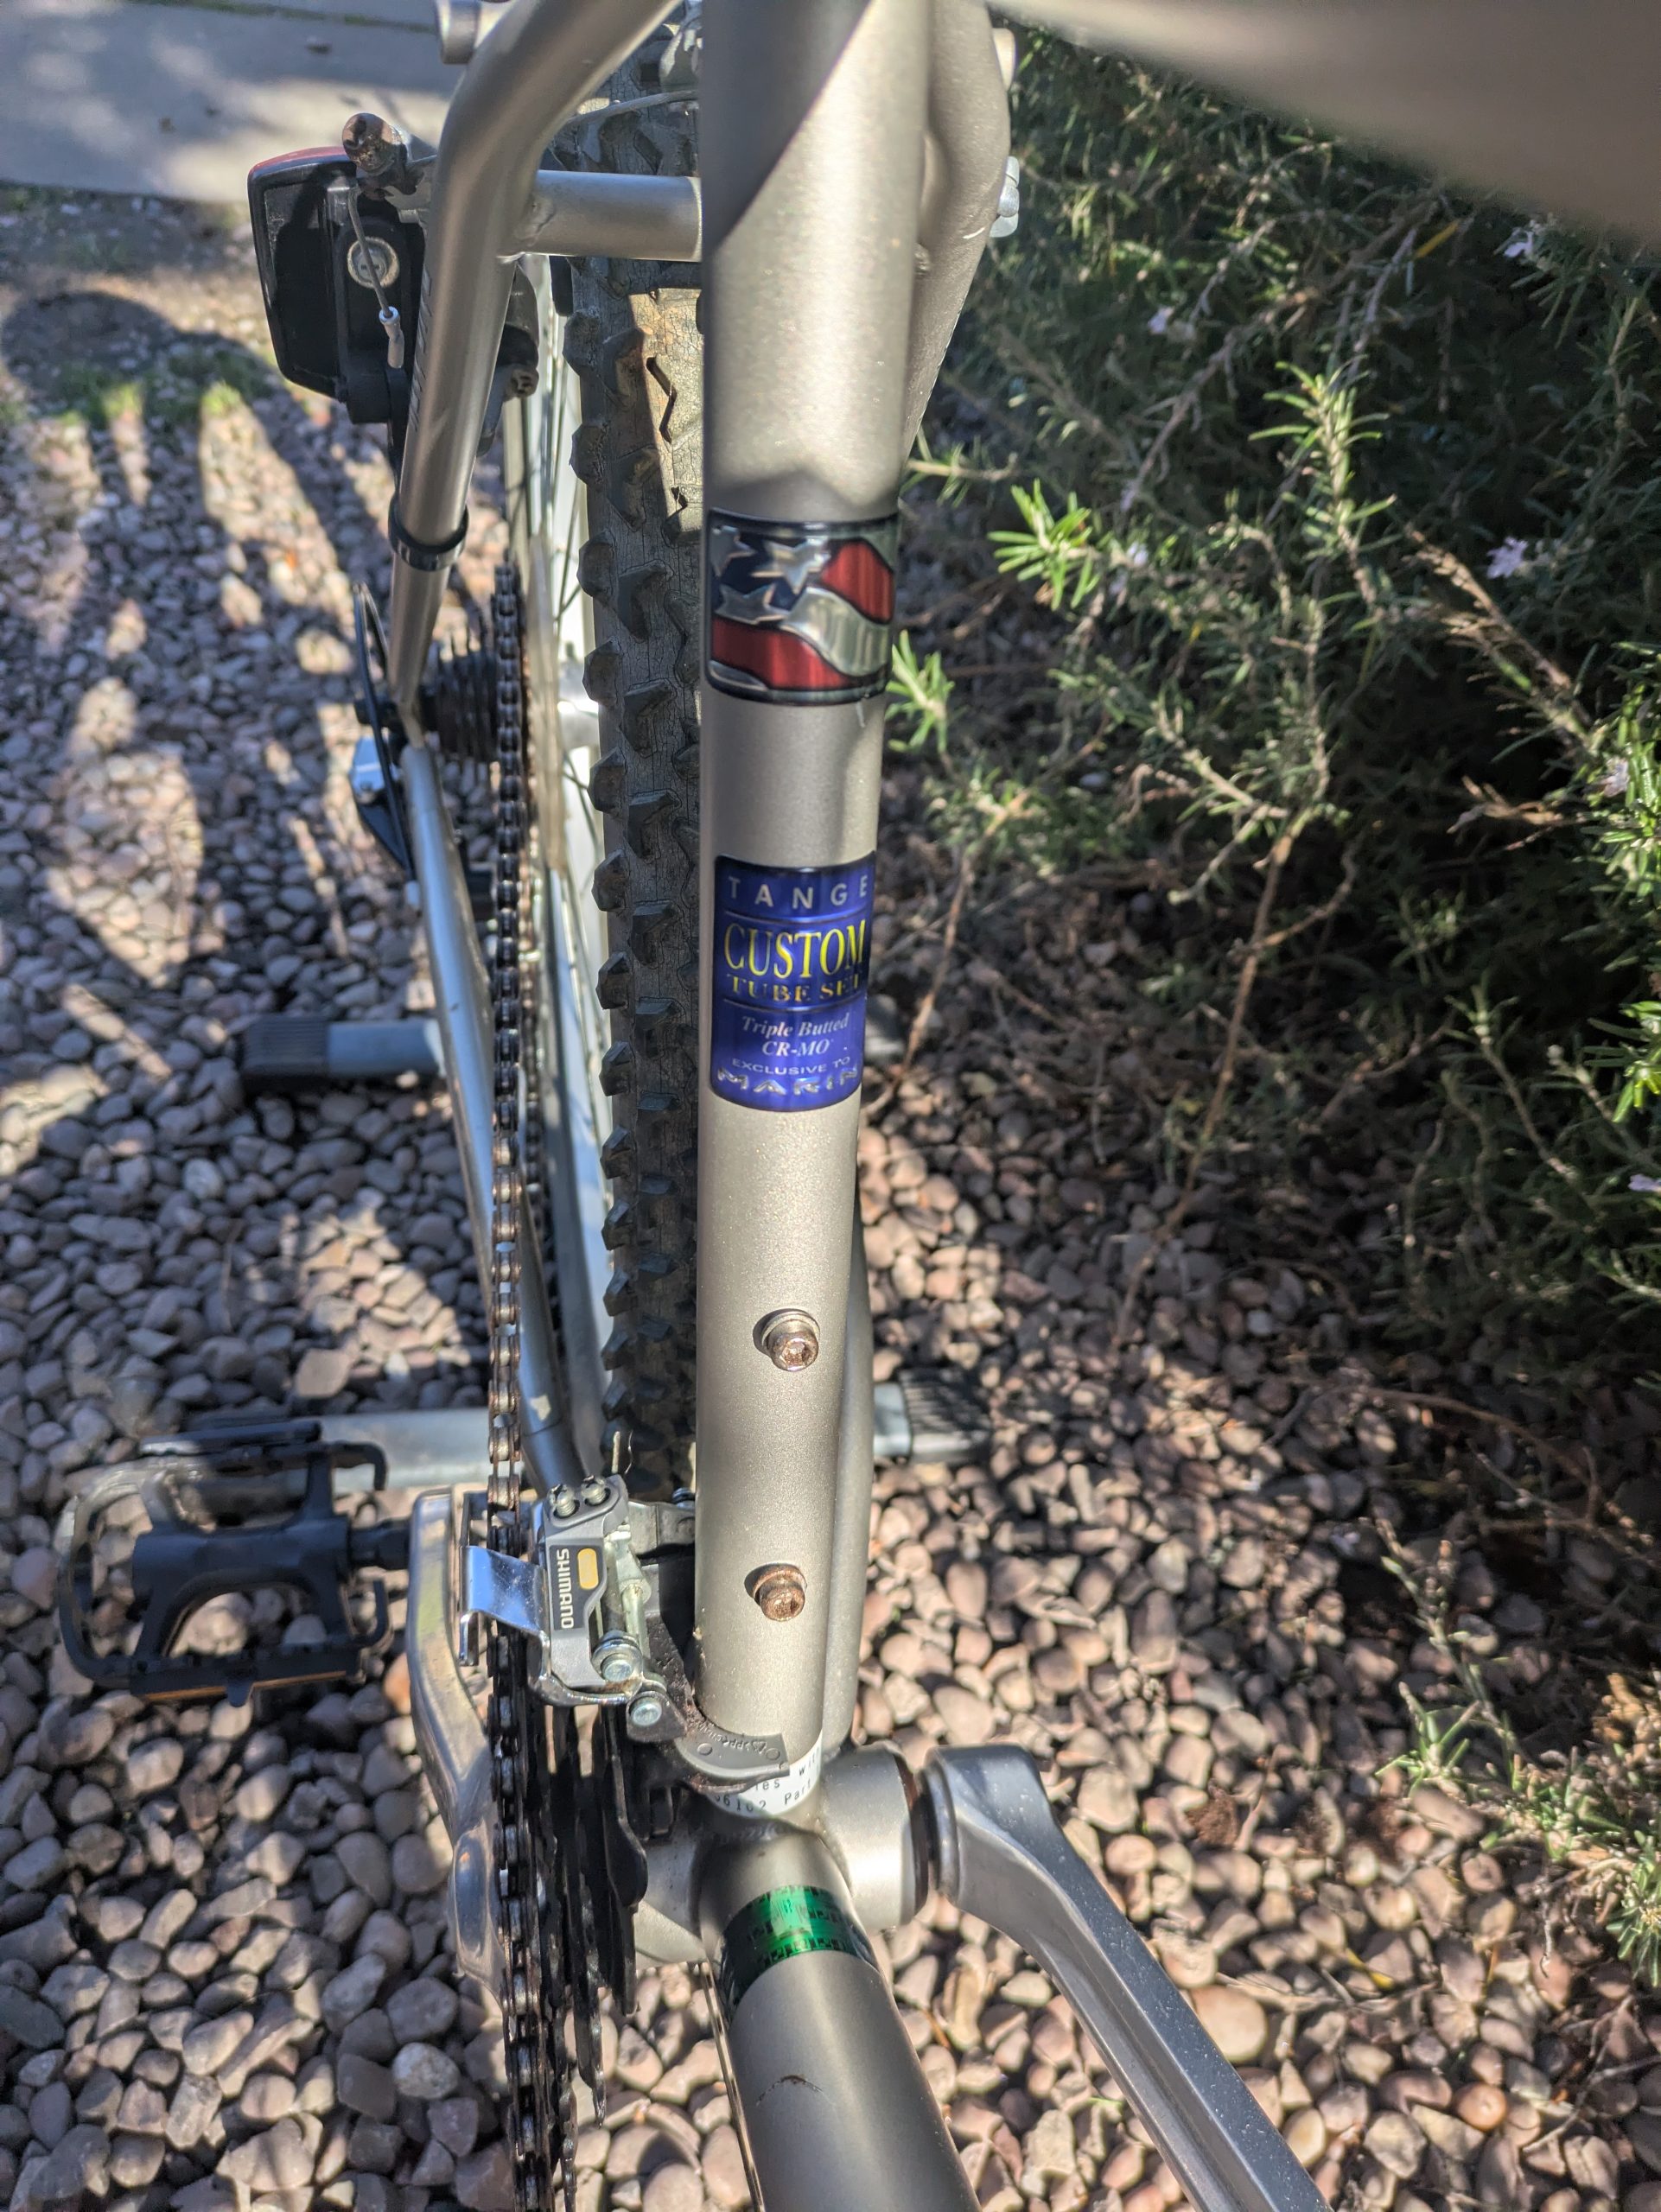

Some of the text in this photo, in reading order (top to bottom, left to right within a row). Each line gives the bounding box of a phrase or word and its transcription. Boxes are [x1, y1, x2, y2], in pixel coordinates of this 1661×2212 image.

[729, 875, 868, 910] TANGE
[724, 919, 866, 979] CUSTOM
[727, 974, 811, 1001] TUBE
[742, 1012, 850, 1038] Triple Butted
[762, 1039, 830, 1057] CR-MO
[732, 1056, 850, 1075] EXCLUSIVE TO
[717, 1065, 857, 1095] MARIN
[556, 1548, 575, 1629] SHIMANO
